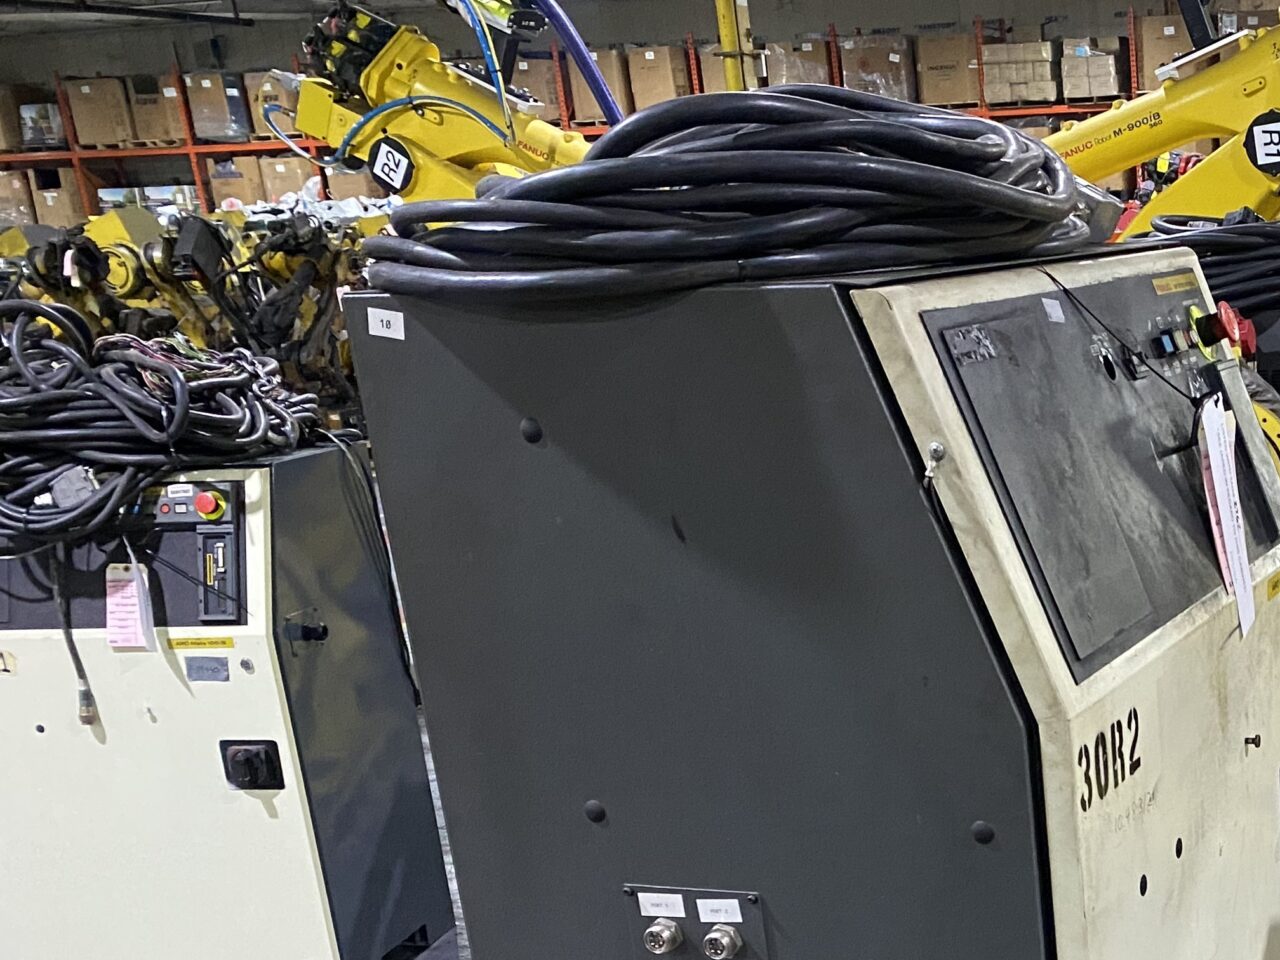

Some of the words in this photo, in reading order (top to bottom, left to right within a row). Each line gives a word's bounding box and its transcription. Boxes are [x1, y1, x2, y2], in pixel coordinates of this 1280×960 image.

[517, 140, 550, 162] FANUC
[1059, 140, 1094, 161] FANUC
[381, 150, 401, 183] R2
[379, 318, 392, 330] 10
[1078, 706, 1142, 813] 30R2
